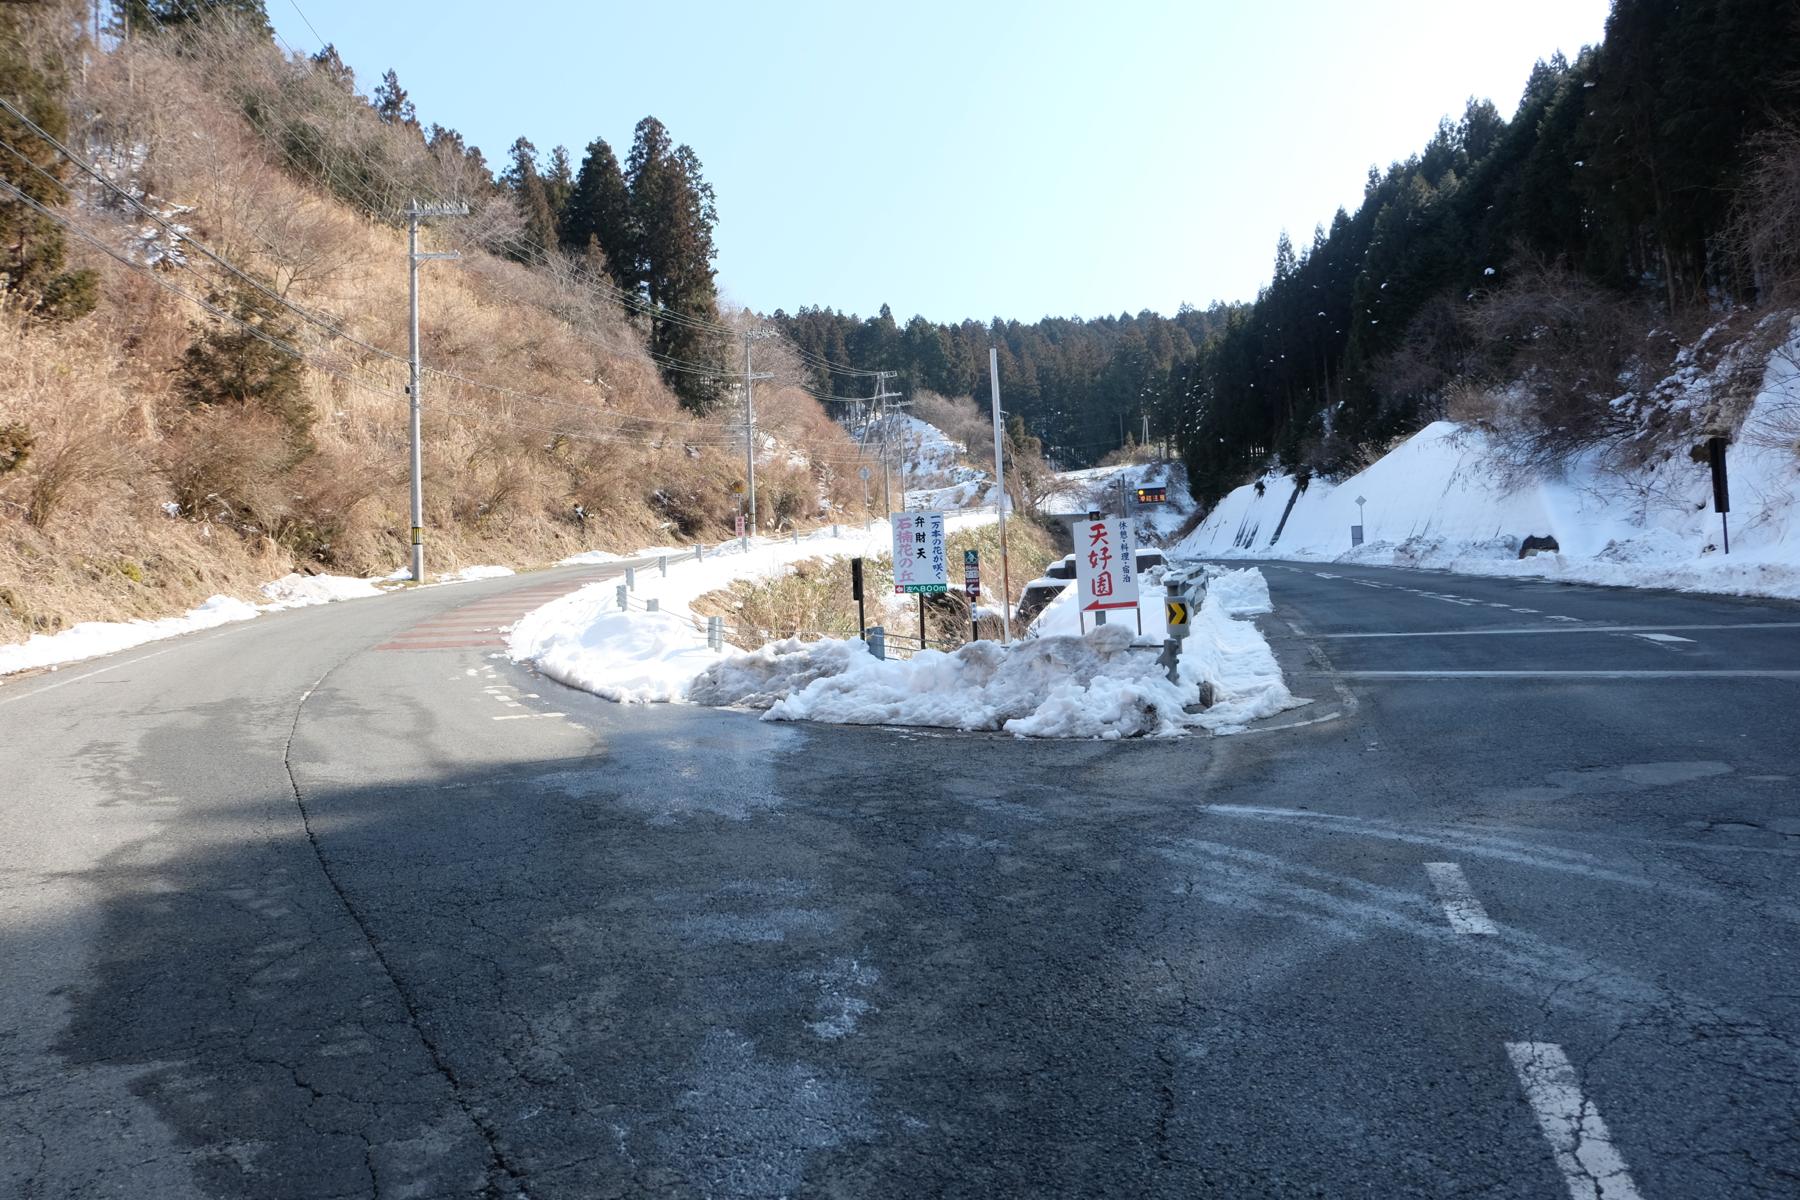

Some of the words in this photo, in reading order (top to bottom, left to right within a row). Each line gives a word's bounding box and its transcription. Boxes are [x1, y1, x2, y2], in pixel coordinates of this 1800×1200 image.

[896, 517, 915, 583] 石楠花の丘
[915, 516, 927, 559] 弁財天
[930, 515, 943, 580] 一万本の花が咲く
[1087, 523, 1113, 597] 天好園
[1119, 521, 1131, 583] 休憩・料理・宿泊
[905, 585, 947, 593] 左へ800m
